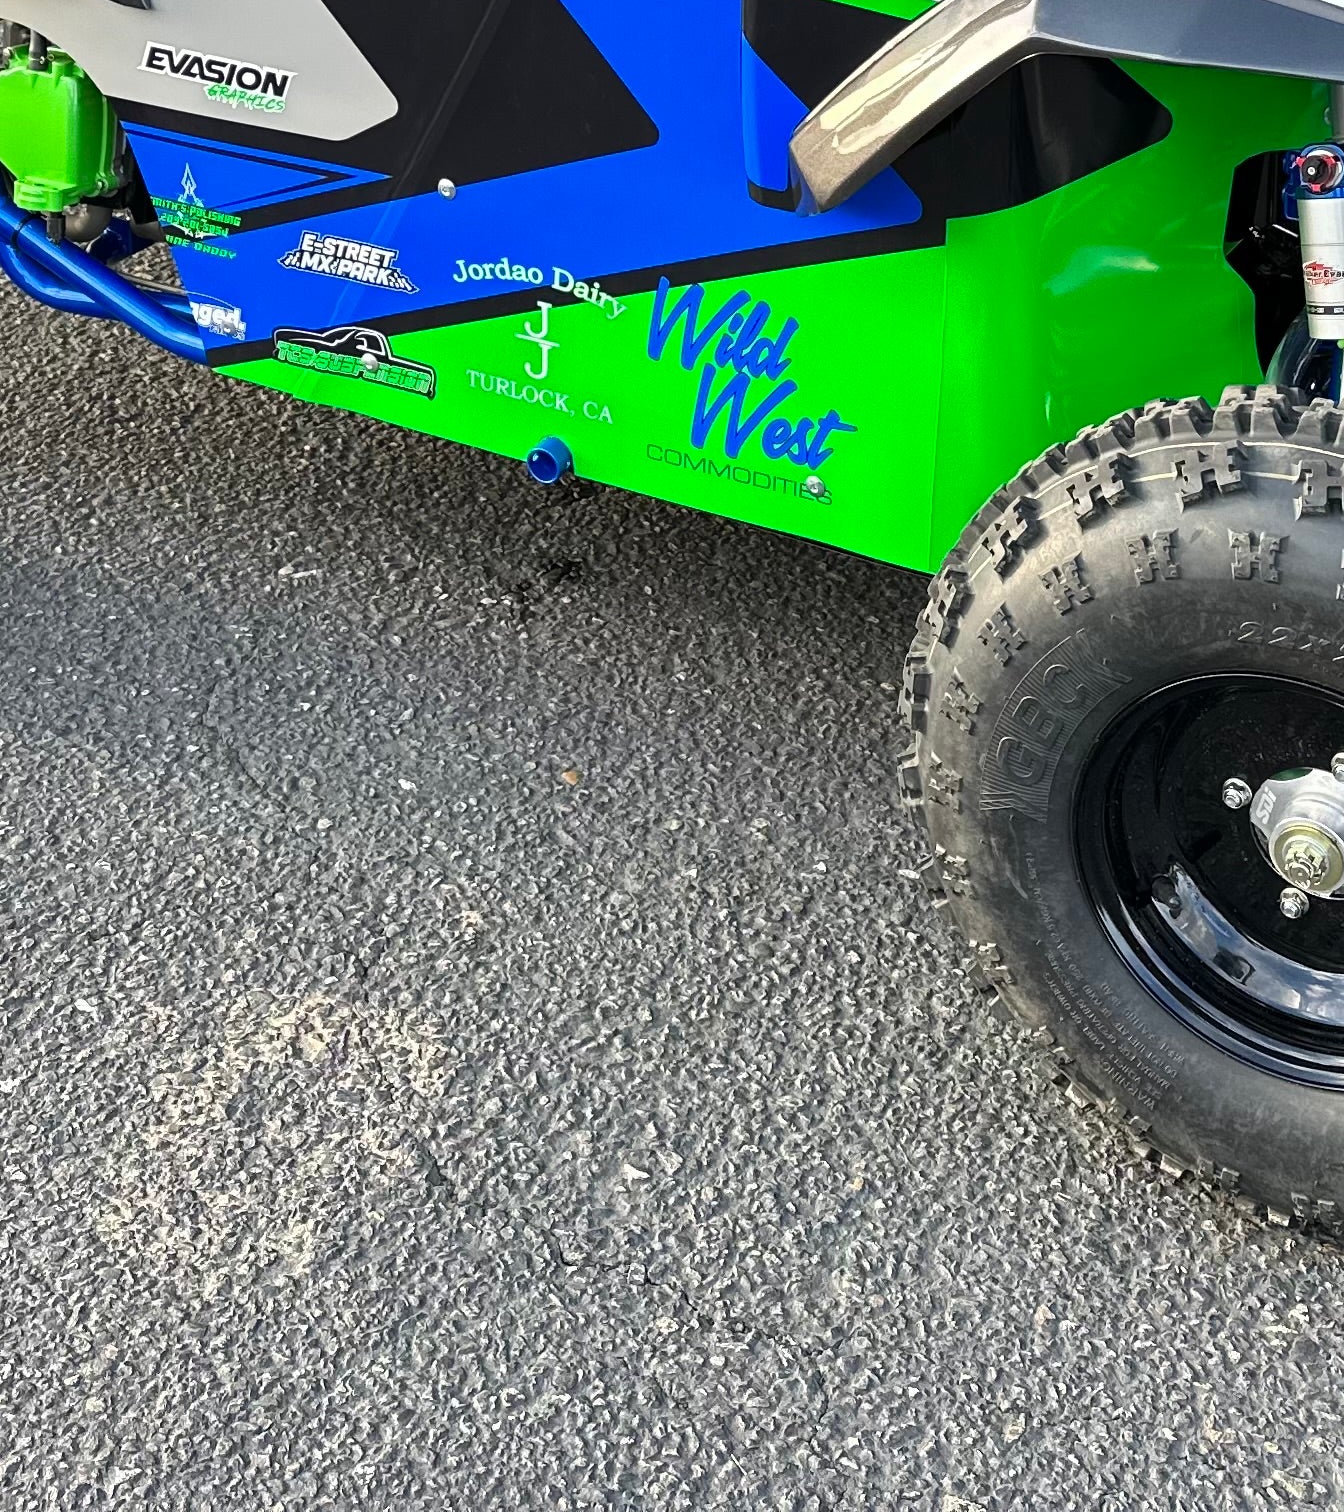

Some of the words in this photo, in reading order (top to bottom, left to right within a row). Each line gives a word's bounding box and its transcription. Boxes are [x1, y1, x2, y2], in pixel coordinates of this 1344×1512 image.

[145, 46, 289, 97] EVASION
[207, 85, 285, 111] GRAPHICS
[194, 242, 236, 259] DADDY
[301, 233, 396, 268] E-STREET
[453, 257, 543, 284] Jordao
[551, 266, 627, 320] Dairy
[648, 276, 799, 381] Wild
[466, 369, 574, 416] TURLOCK,
[583, 401, 613, 424] CA
[691, 363, 858, 470] West
[647, 444, 833, 505] COMMODITIES
